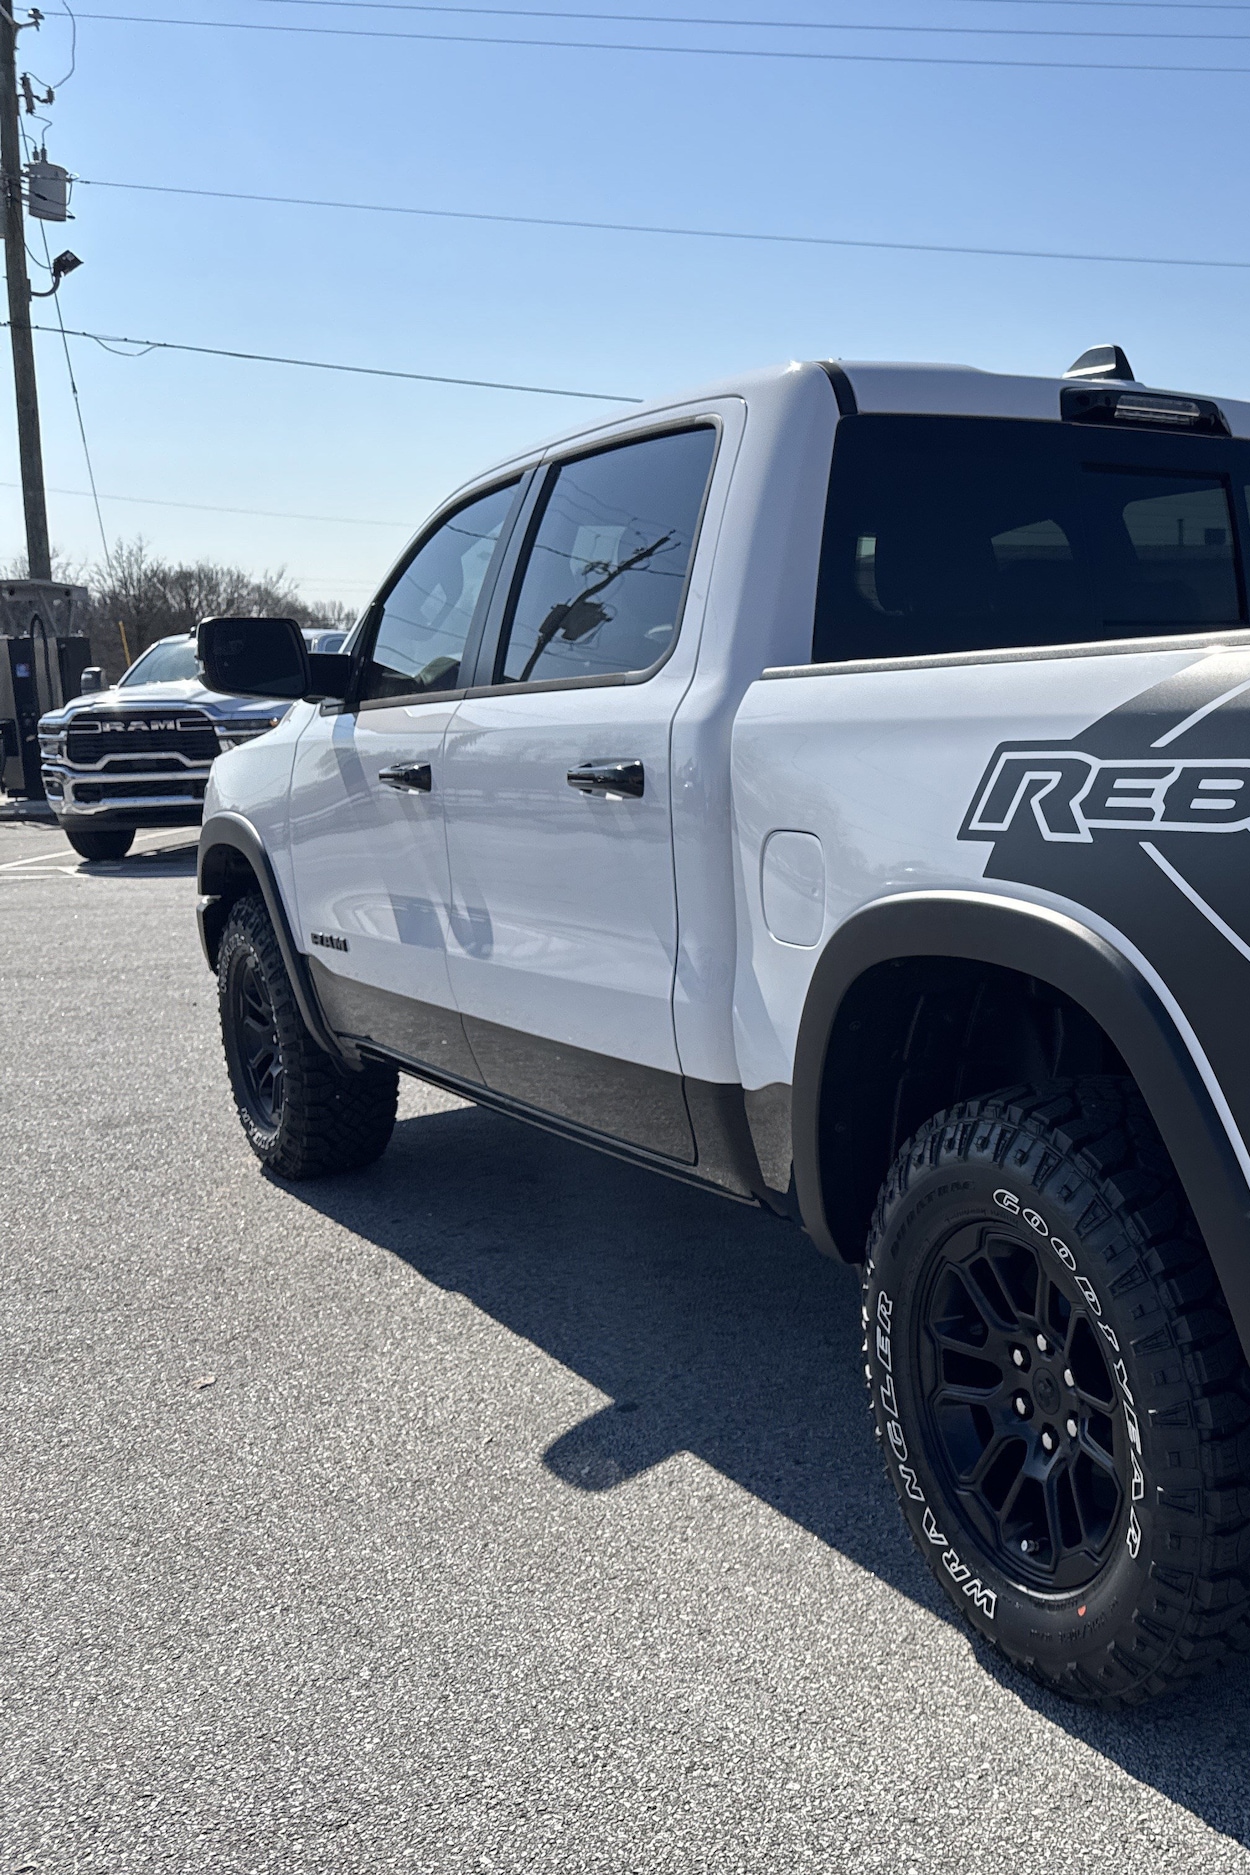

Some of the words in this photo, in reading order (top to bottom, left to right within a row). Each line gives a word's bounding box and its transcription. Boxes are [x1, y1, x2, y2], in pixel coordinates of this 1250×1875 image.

[101, 719, 176, 733] RAM
[876, 1290, 998, 1620] WRANGLER
[993, 1188, 1144, 1560] GOODYEAR
